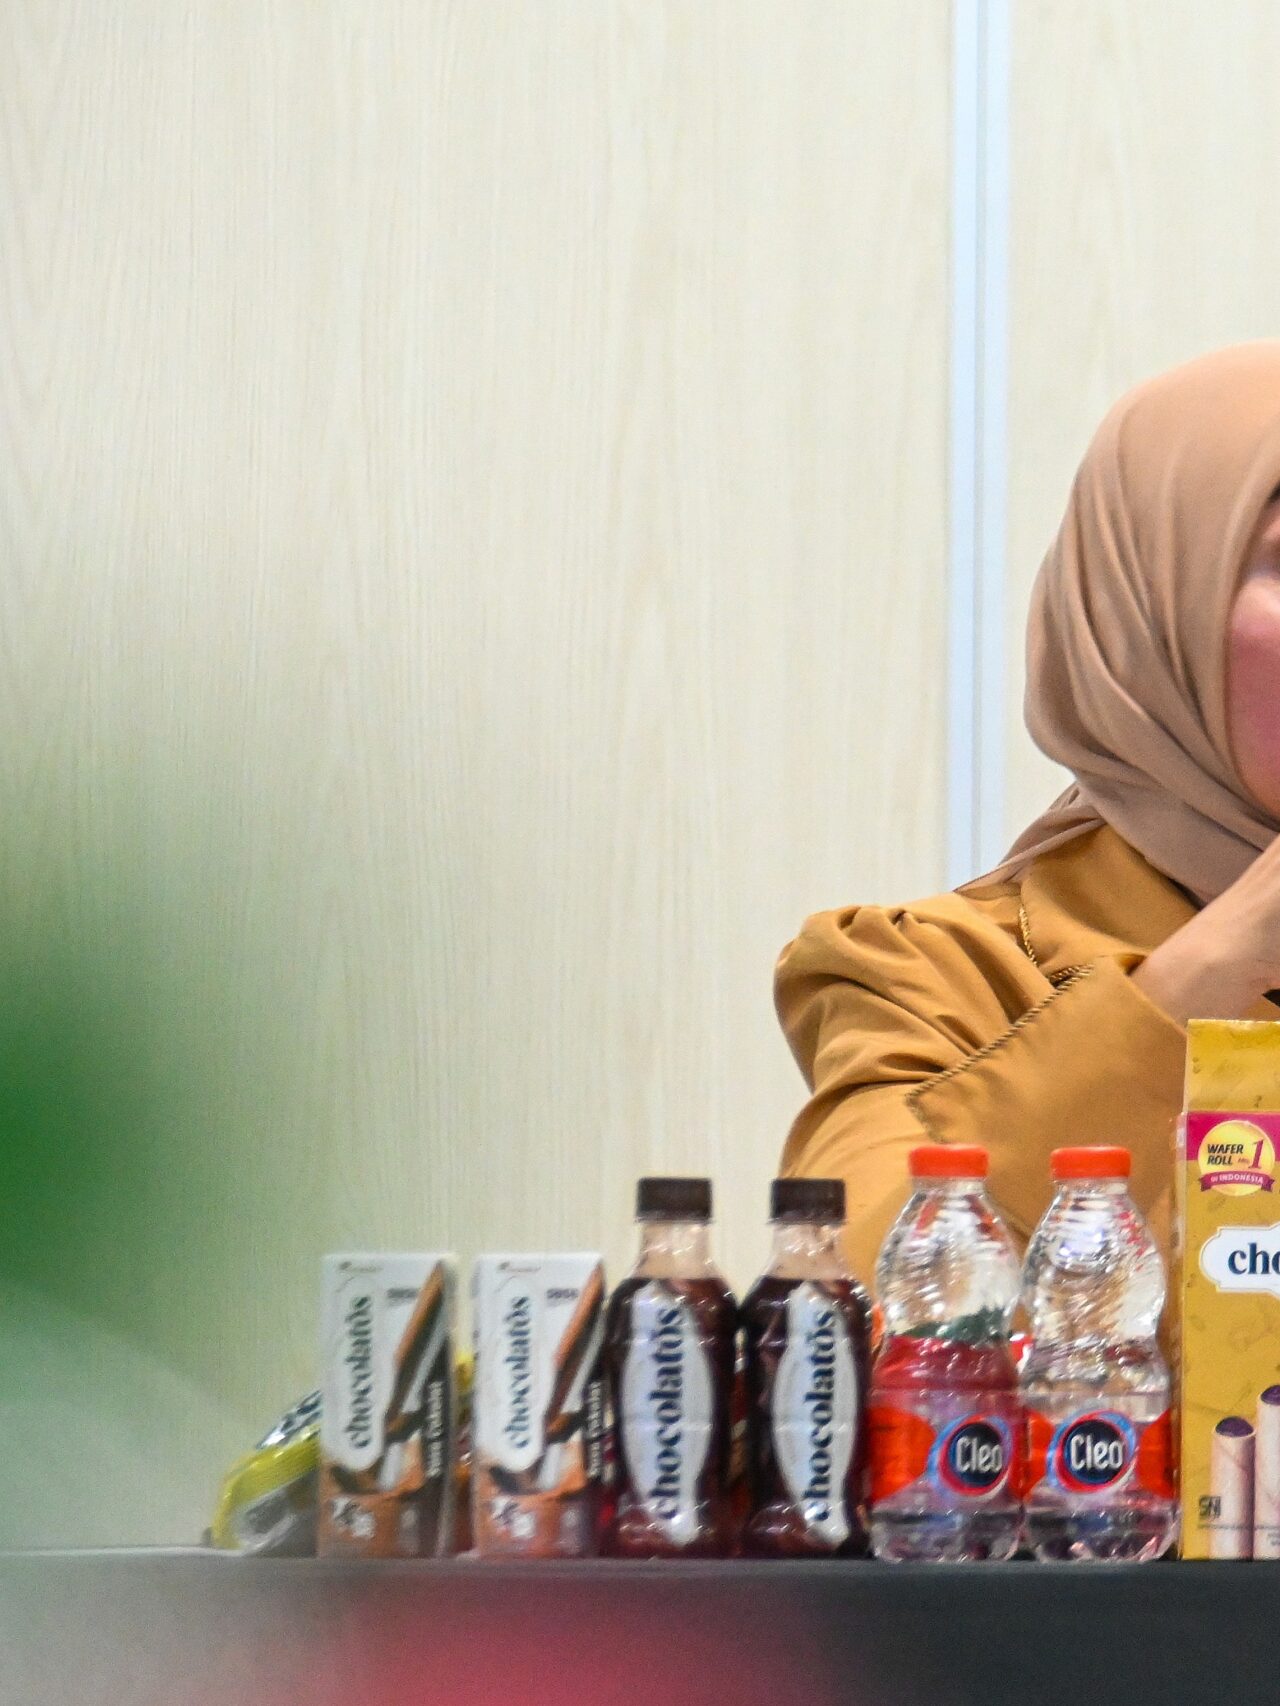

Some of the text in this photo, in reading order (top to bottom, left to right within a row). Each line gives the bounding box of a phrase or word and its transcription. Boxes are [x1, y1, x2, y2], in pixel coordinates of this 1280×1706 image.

[1207, 1143, 1244, 1155] WAFER
[1207, 1155, 1233, 1166] ROLL
[1219, 1173, 1264, 1184] INDONESIA
[955, 1435, 1002, 1473] Cleo
[1070, 1433, 1124, 1471] Cleo
